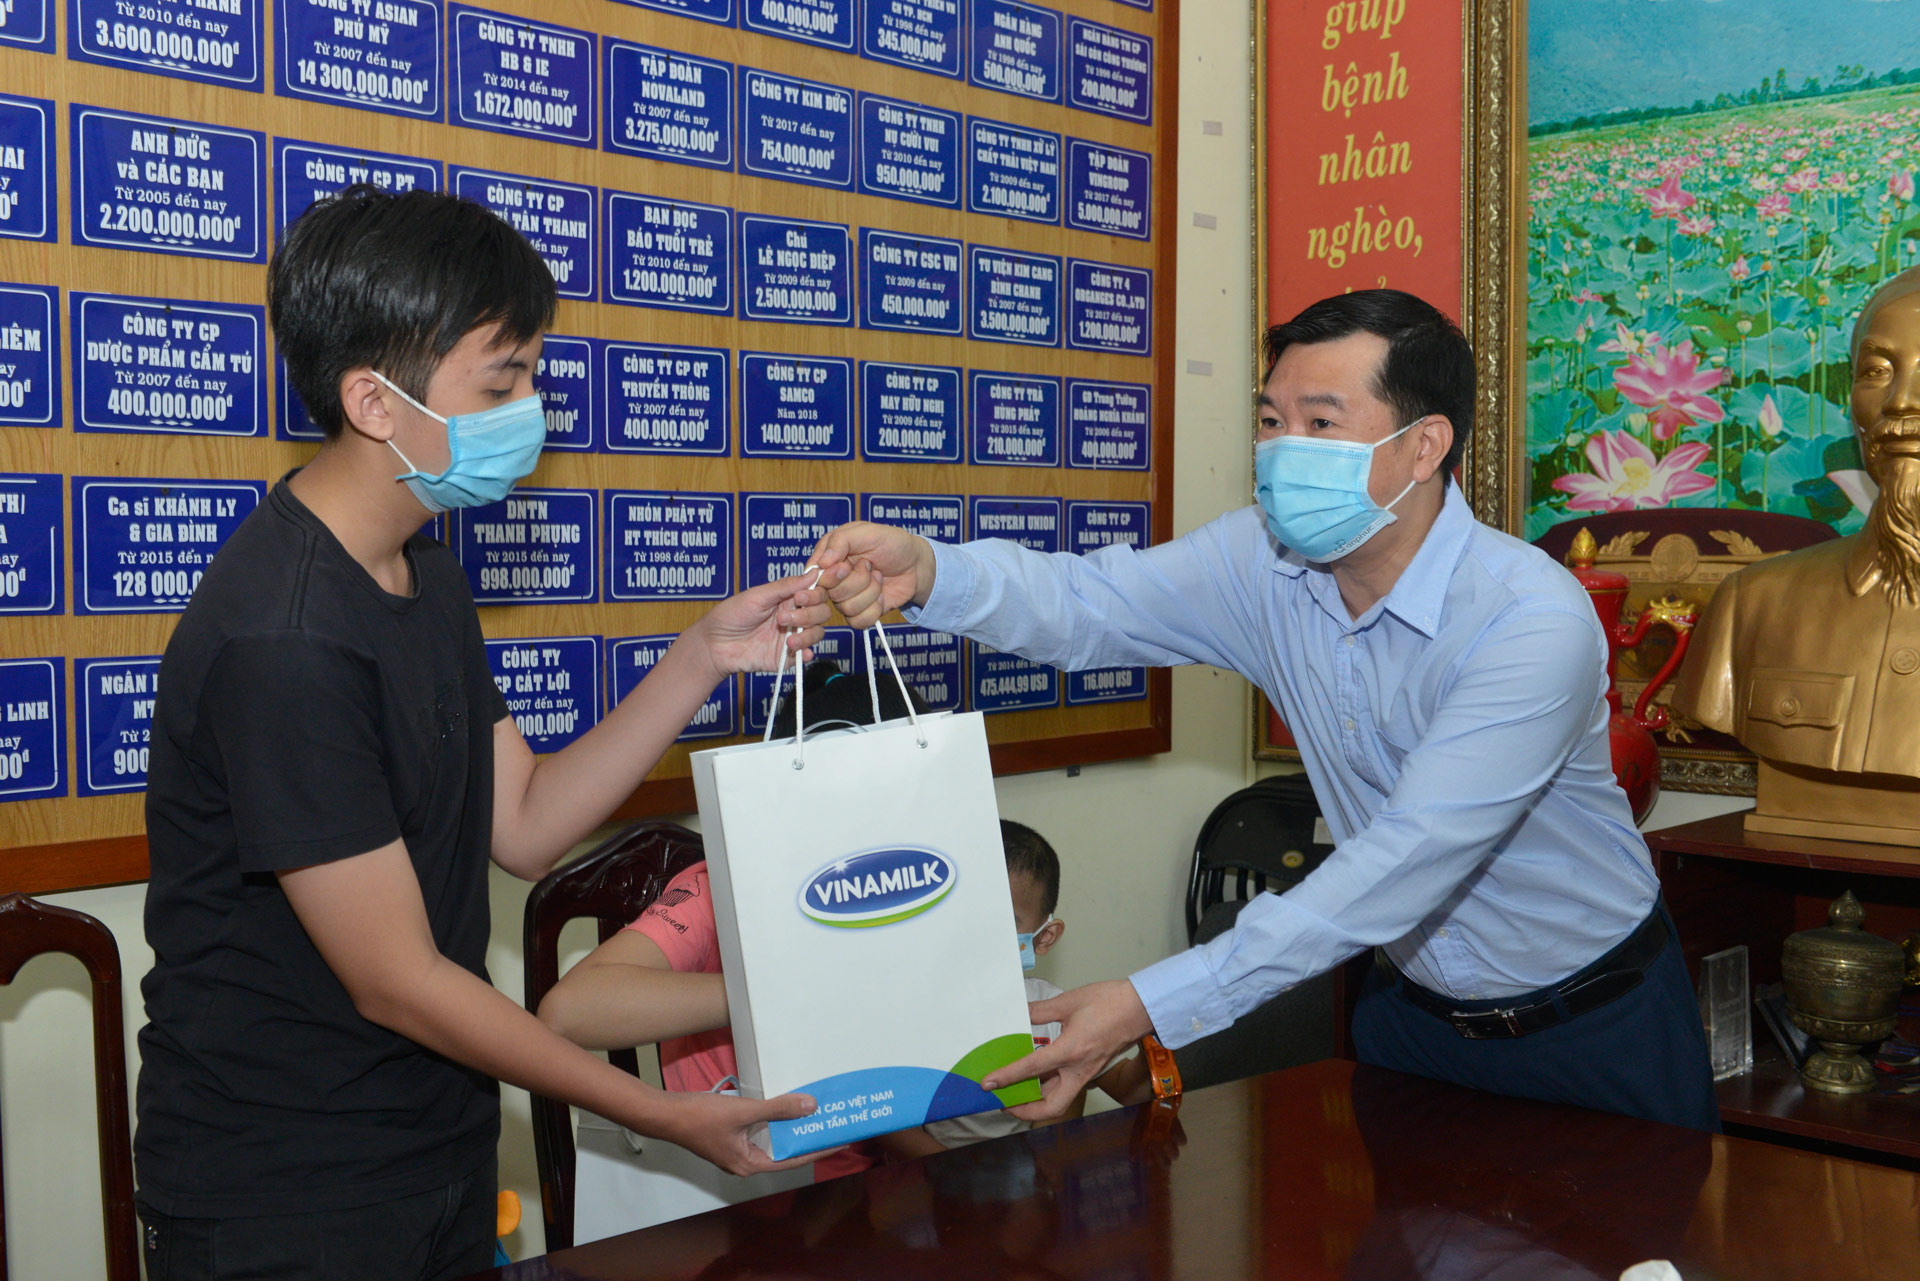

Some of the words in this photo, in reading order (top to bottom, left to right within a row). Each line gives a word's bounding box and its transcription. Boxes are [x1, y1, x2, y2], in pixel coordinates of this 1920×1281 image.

[115, 1, 135, 17] Từ
[138, 6, 172, 24] 2010
[176, 12, 201, 30] đến
[205, 22, 229, 38] nay
[353, 0, 371, 16] TY
[375, 3, 418, 27] ASIAN
[478, 21, 514, 46] CÔNG
[518, 30, 536, 50] TY
[539, 34, 575, 58] TNHH
[314, 41, 330, 56] Từ
[333, 45, 362, 62] 2007
[366, 52, 388, 67] đến
[391, 59, 412, 74] nay
[500, 51, 519, 70] HB
[523, 56, 532, 74] &
[536, 58, 549, 77] IE
[640, 54, 667, 82] TẬP
[669, 58, 702, 84] ĐOÀN
[483, 72, 498, 86] Từ
[500, 76, 526, 91] 2014
[529, 80, 548, 95] đến
[551, 87, 569, 101] nay
[642, 80, 705, 108] NOVALAND
[752, 78, 782, 101] CÔNG
[784, 86, 799, 104] TY
[802, 90, 823, 109] KIM
[825, 92, 847, 114] ĐỨC
[1321, 51, 1409, 118] bệnh
[131, 130, 169, 155] ANH
[174, 133, 210, 160] ĐỨC
[1318, 130, 1412, 186] nhân
[117, 158, 139, 180] và
[145, 158, 181, 185] CÁC
[187, 166, 224, 194] BẠN
[1089, 172, 1129, 192] VINGROUP
[114, 186, 134, 200] Từ
[136, 189, 170, 205] 2005
[175, 192, 200, 208] đến
[204, 200, 227, 214] nay
[487, 183, 522, 207] CÔNG
[526, 191, 544, 210] TY
[547, 194, 564, 212] CP
[512, 210, 539, 232] TÂN
[542, 219, 588, 240] THANH
[644, 206, 670, 228] BẠN
[673, 211, 697, 232] ĐỌC
[627, 226, 652, 249] BÁO
[656, 228, 686, 253] TUỔI
[688, 234, 713, 257] TRẺ
[786, 230, 808, 248] Chú
[1307, 205, 1423, 269] nghèo,
[550, 244, 568, 257] nay
[764, 273, 776, 284] Từ
[777, 274, 798, 285] 2009
[800, 274, 815, 287] đến
[816, 279, 831, 290] nay
[123, 312, 167, 337] CÔNG
[172, 320, 194, 340] TY
[199, 322, 220, 342] CP
[87, 338, 132, 366] DƯỢC
[138, 340, 185, 368] PHẨM
[190, 343, 225, 372] CẨM
[230, 350, 252, 374] TÚ
[623, 354, 654, 374] CÔNG
[657, 359, 673, 375] TY
[676, 360, 690, 376] CP
[693, 361, 708, 378] QT
[550, 359, 585, 379] OPPO
[796, 366, 811, 382] TY
[813, 368, 827, 384] CP
[115, 370, 134, 384] Từ
[137, 372, 171, 386] 2007
[175, 374, 200, 389] đến
[204, 380, 227, 394] nay
[672, 381, 710, 401] THÔNG
[780, 386, 815, 403] SAMCO
[777, 408, 796, 419] Năm
[798, 409, 818, 420] 2018
[108, 496, 129, 516] Ca
[134, 497, 149, 516] sĩ
[154, 493, 211, 516] KHÁNH
[216, 498, 236, 517] LY
[506, 500, 548, 520] DNTN
[628, 503, 662, 522] NHÓM
[665, 504, 695, 526] PHẬT
[698, 503, 714, 524] TỬ
[129, 524, 140, 542] &
[146, 523, 174, 542] GIA
[178, 519, 217, 542] ĐÌNH
[979, 515, 1025, 530] WESTERN
[1027, 515, 1055, 530] UNION
[474, 524, 526, 543] THANH
[531, 524, 580, 548] PHỤNG
[624, 530, 641, 546] HT
[644, 527, 678, 546] THÍCH
[681, 526, 717, 548] QUẢNG
[118, 551, 137, 564] Từ
[140, 551, 173, 564] 2015
[178, 549, 202, 564] đến
[634, 551, 647, 562] Từ
[650, 552, 671, 562] 1998
[673, 550, 690, 562] đến
[692, 554, 708, 565] nay
[502, 646, 538, 668] CÔNG
[542, 648, 561, 666] TY
[515, 669, 543, 693] CÁT
[547, 669, 570, 694] LỢI
[1030, 674, 1048, 691] USD
[1083, 672, 1114, 690] 116.000
[1116, 670, 1132, 688] USD
[7, 701, 49, 722] LINH
[506, 699, 532, 711] 2007
[534, 696, 553, 710] đến
[556, 698, 574, 710] nay
[814, 861, 943, 906] VINAMILK
[824, 1101, 846, 1113] CAO
[848, 1095, 867, 1108] VIỆT
[870, 1090, 894, 1103] NAM
[792, 1121, 824, 1136] VƯƠN
[849, 1109, 868, 1124] THẾ
[870, 1104, 893, 1119] GIỚI
